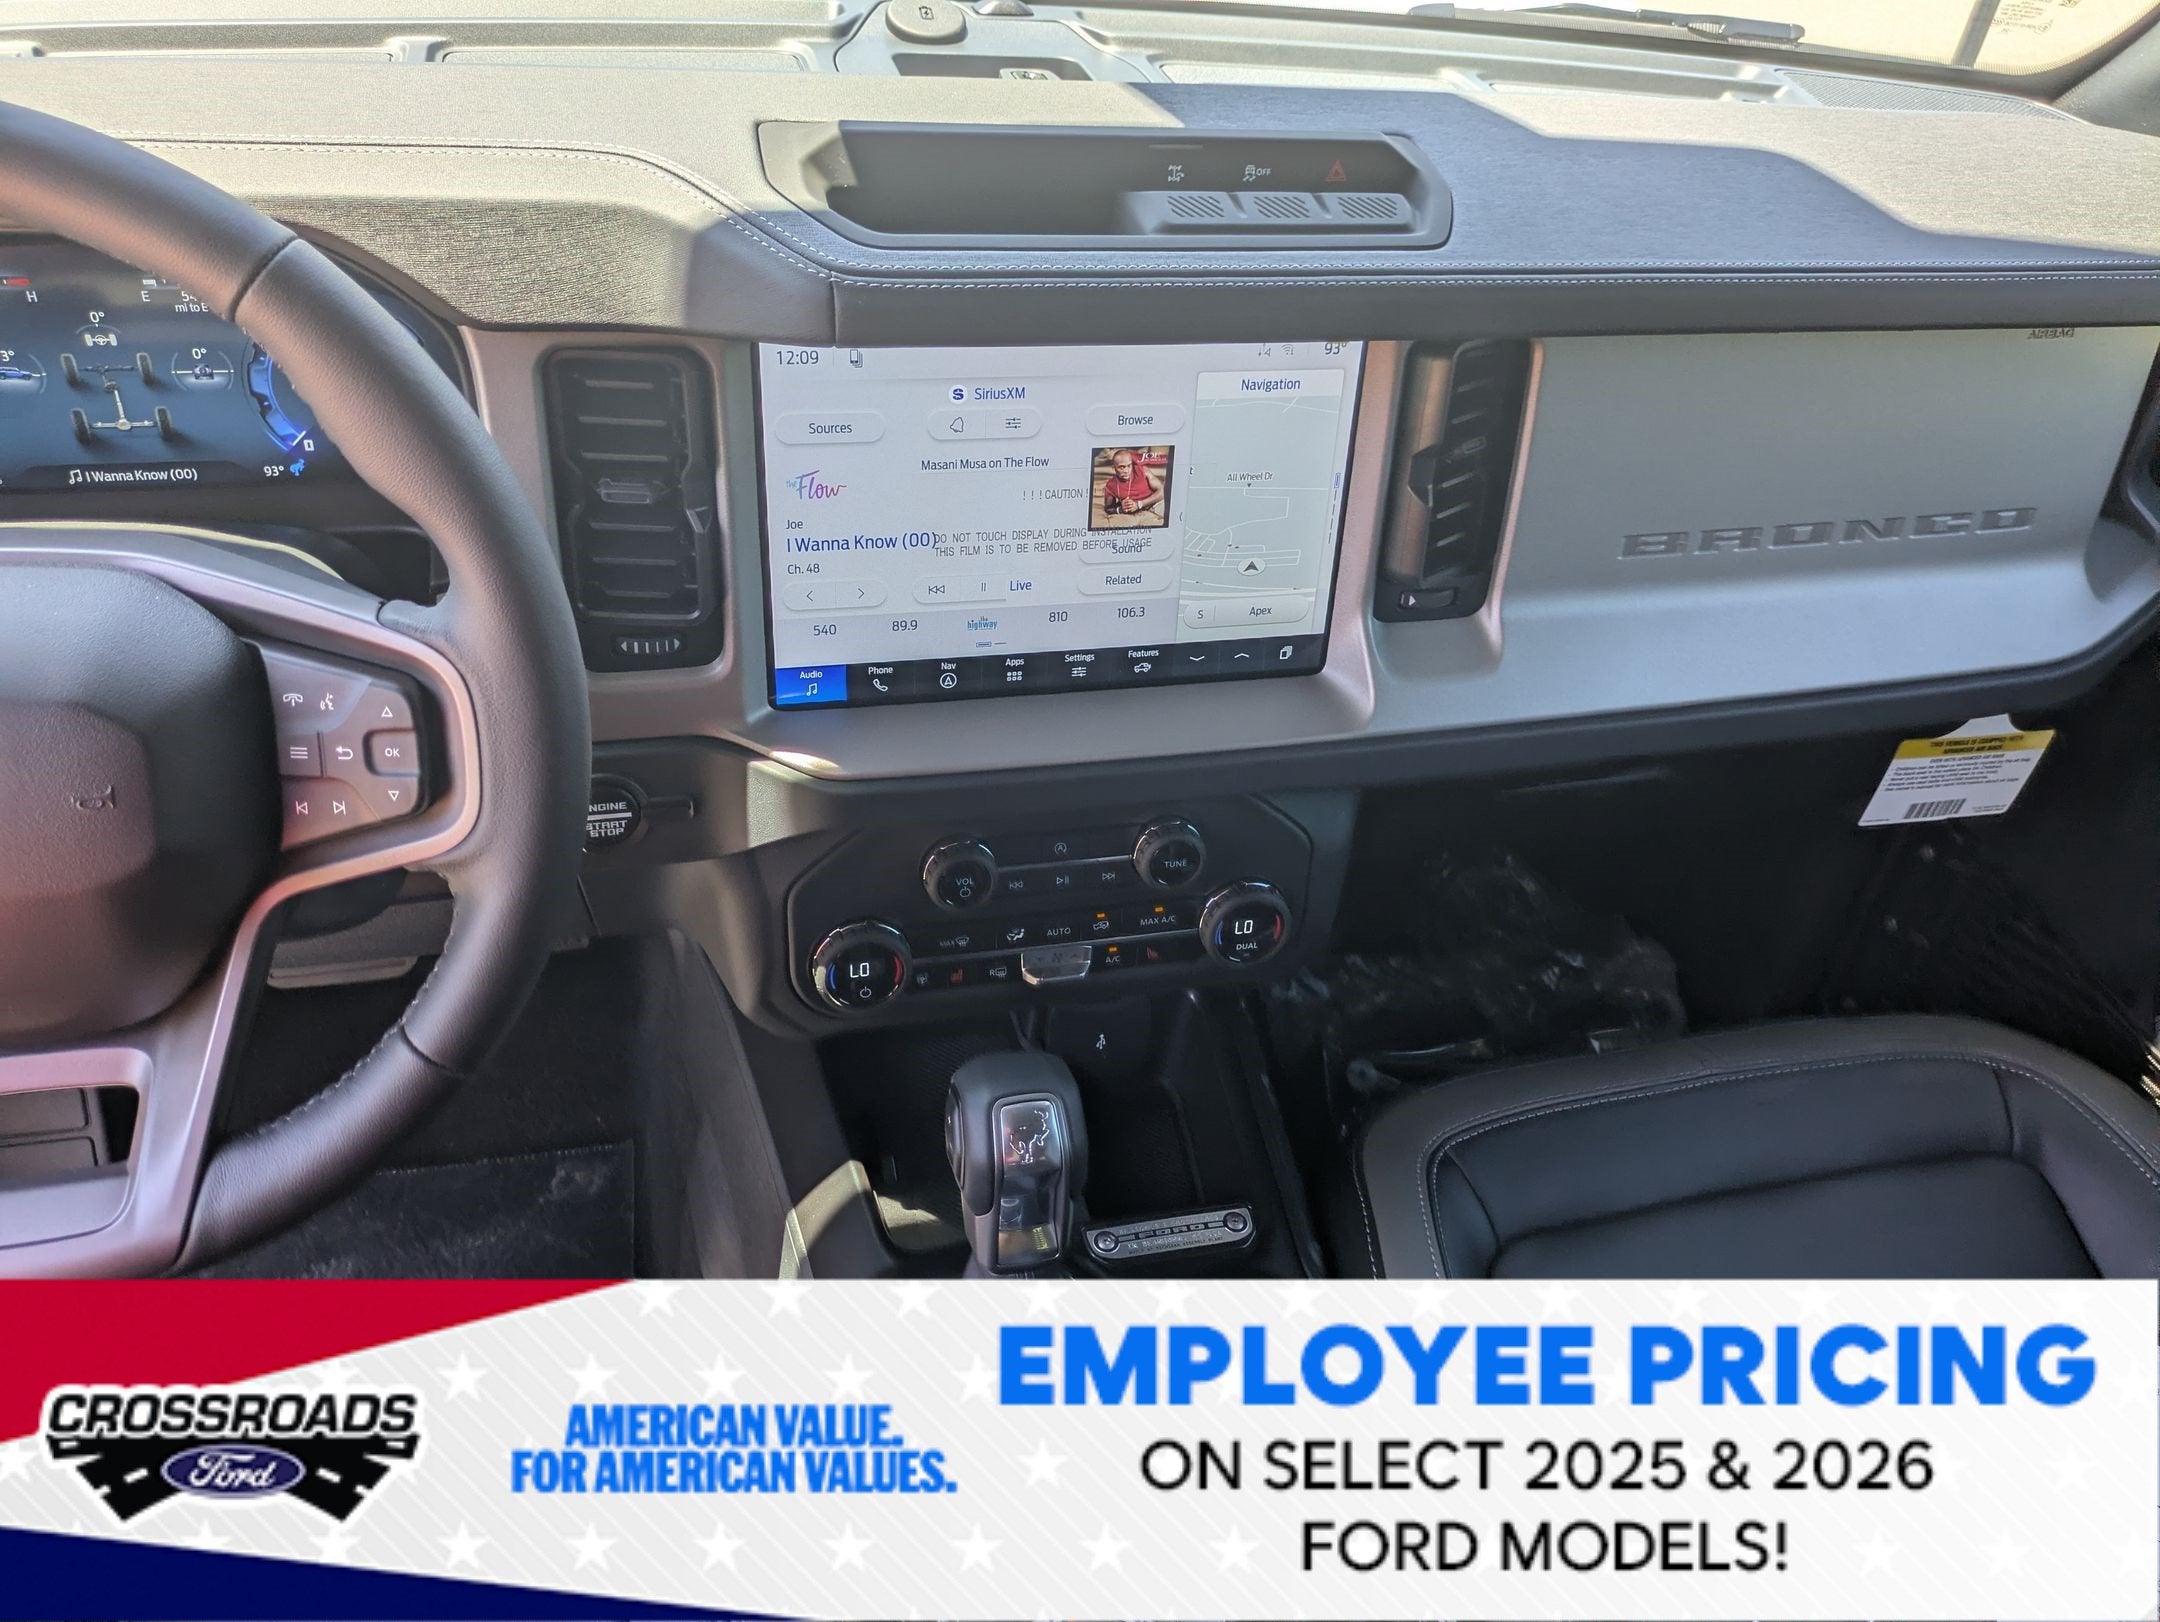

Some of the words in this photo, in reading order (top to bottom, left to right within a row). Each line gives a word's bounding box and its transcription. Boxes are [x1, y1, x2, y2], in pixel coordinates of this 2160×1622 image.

[26, 291, 38, 302] H
[141, 291, 150, 302] E
[189, 303, 201, 312] to
[776, 350, 819, 366] 12:09
[1241, 378, 1301, 393] Navigation
[974, 387, 1026, 401] SiriusXM
[1117, 415, 1153, 427] Browse
[808, 423, 852, 434] Sources
[921, 459, 958, 470] Masani
[960, 458, 987, 469] Musa
[989, 460, 1001, 469] on
[1004, 457, 1023, 468] The
[1025, 456, 1049, 468] Flow
[92, 470, 134, 483] Wanna
[135, 469, 168, 481] Know
[170, 467, 198, 481] (00)
[1227, 473, 1238, 482] All
[1239, 472, 1262, 482] Wheel
[1264, 471, 1273, 481] Dr
[796, 470, 847, 500] Flow
[1045, 488, 1083, 499] CAUTION
[786, 519, 803, 530] Joe
[953, 532, 971, 543] NOT
[976, 531, 1007, 542] TOUCH
[1012, 530, 1048, 541] DISPLAY
[1054, 528, 1087, 538] DURING
[1617, 507, 2039, 560] BRONCO
[786, 538, 791, 552] I
[795, 537, 850, 552] Wanna
[855, 534, 897, 549] Know
[902, 531, 937, 550] (00)
[935, 546, 955, 557] THIS
[960, 545, 981, 556] FILM
[986, 545, 995, 555] IS
[1000, 544, 1011, 554] TO
[1017, 542, 1028, 553] BE
[1034, 541, 1077, 552] REMOVED
[1083, 539, 1117, 550] BEFORE
[1122, 537, 1152, 548] USAGE
[787, 563, 805, 575] Ch.
[806, 563, 820, 574] 48
[1105, 574, 1142, 585] Related
[1010, 580, 1032, 591] Live
[1049, 611, 1068, 623] 810
[1117, 607, 1145, 619] 106.3
[1197, 610, 1204, 619] S
[1249, 606, 1272, 617] Apex
[813, 625, 837, 636] 540
[892, 619, 918, 632] 89.9
[967, 619, 998, 631] highway
[1064, 652, 1095, 663] Settings
[1128, 648, 1159, 658] Features
[941, 662, 956, 671] Nav
[1005, 657, 1025, 668] Apps
[800, 670, 823, 679] Audio
[868, 665, 893, 675] Phone
[385, 748, 400, 757] OK
[588, 801, 628, 812] NGINE
[590, 827, 625, 838] STOP
[1164, 859, 1187, 868] TUNE
[956, 878, 975, 886] VOL
[1140, 917, 1158, 926] MAX
[1160, 915, 1177, 923] A/C
[1047, 927, 1071, 936] AUTO
[1234, 919, 1253, 935] LO
[1236, 942, 1258, 951] DUAL
[1105, 955, 1120, 963] A/C
[850, 962, 870, 978] LO
